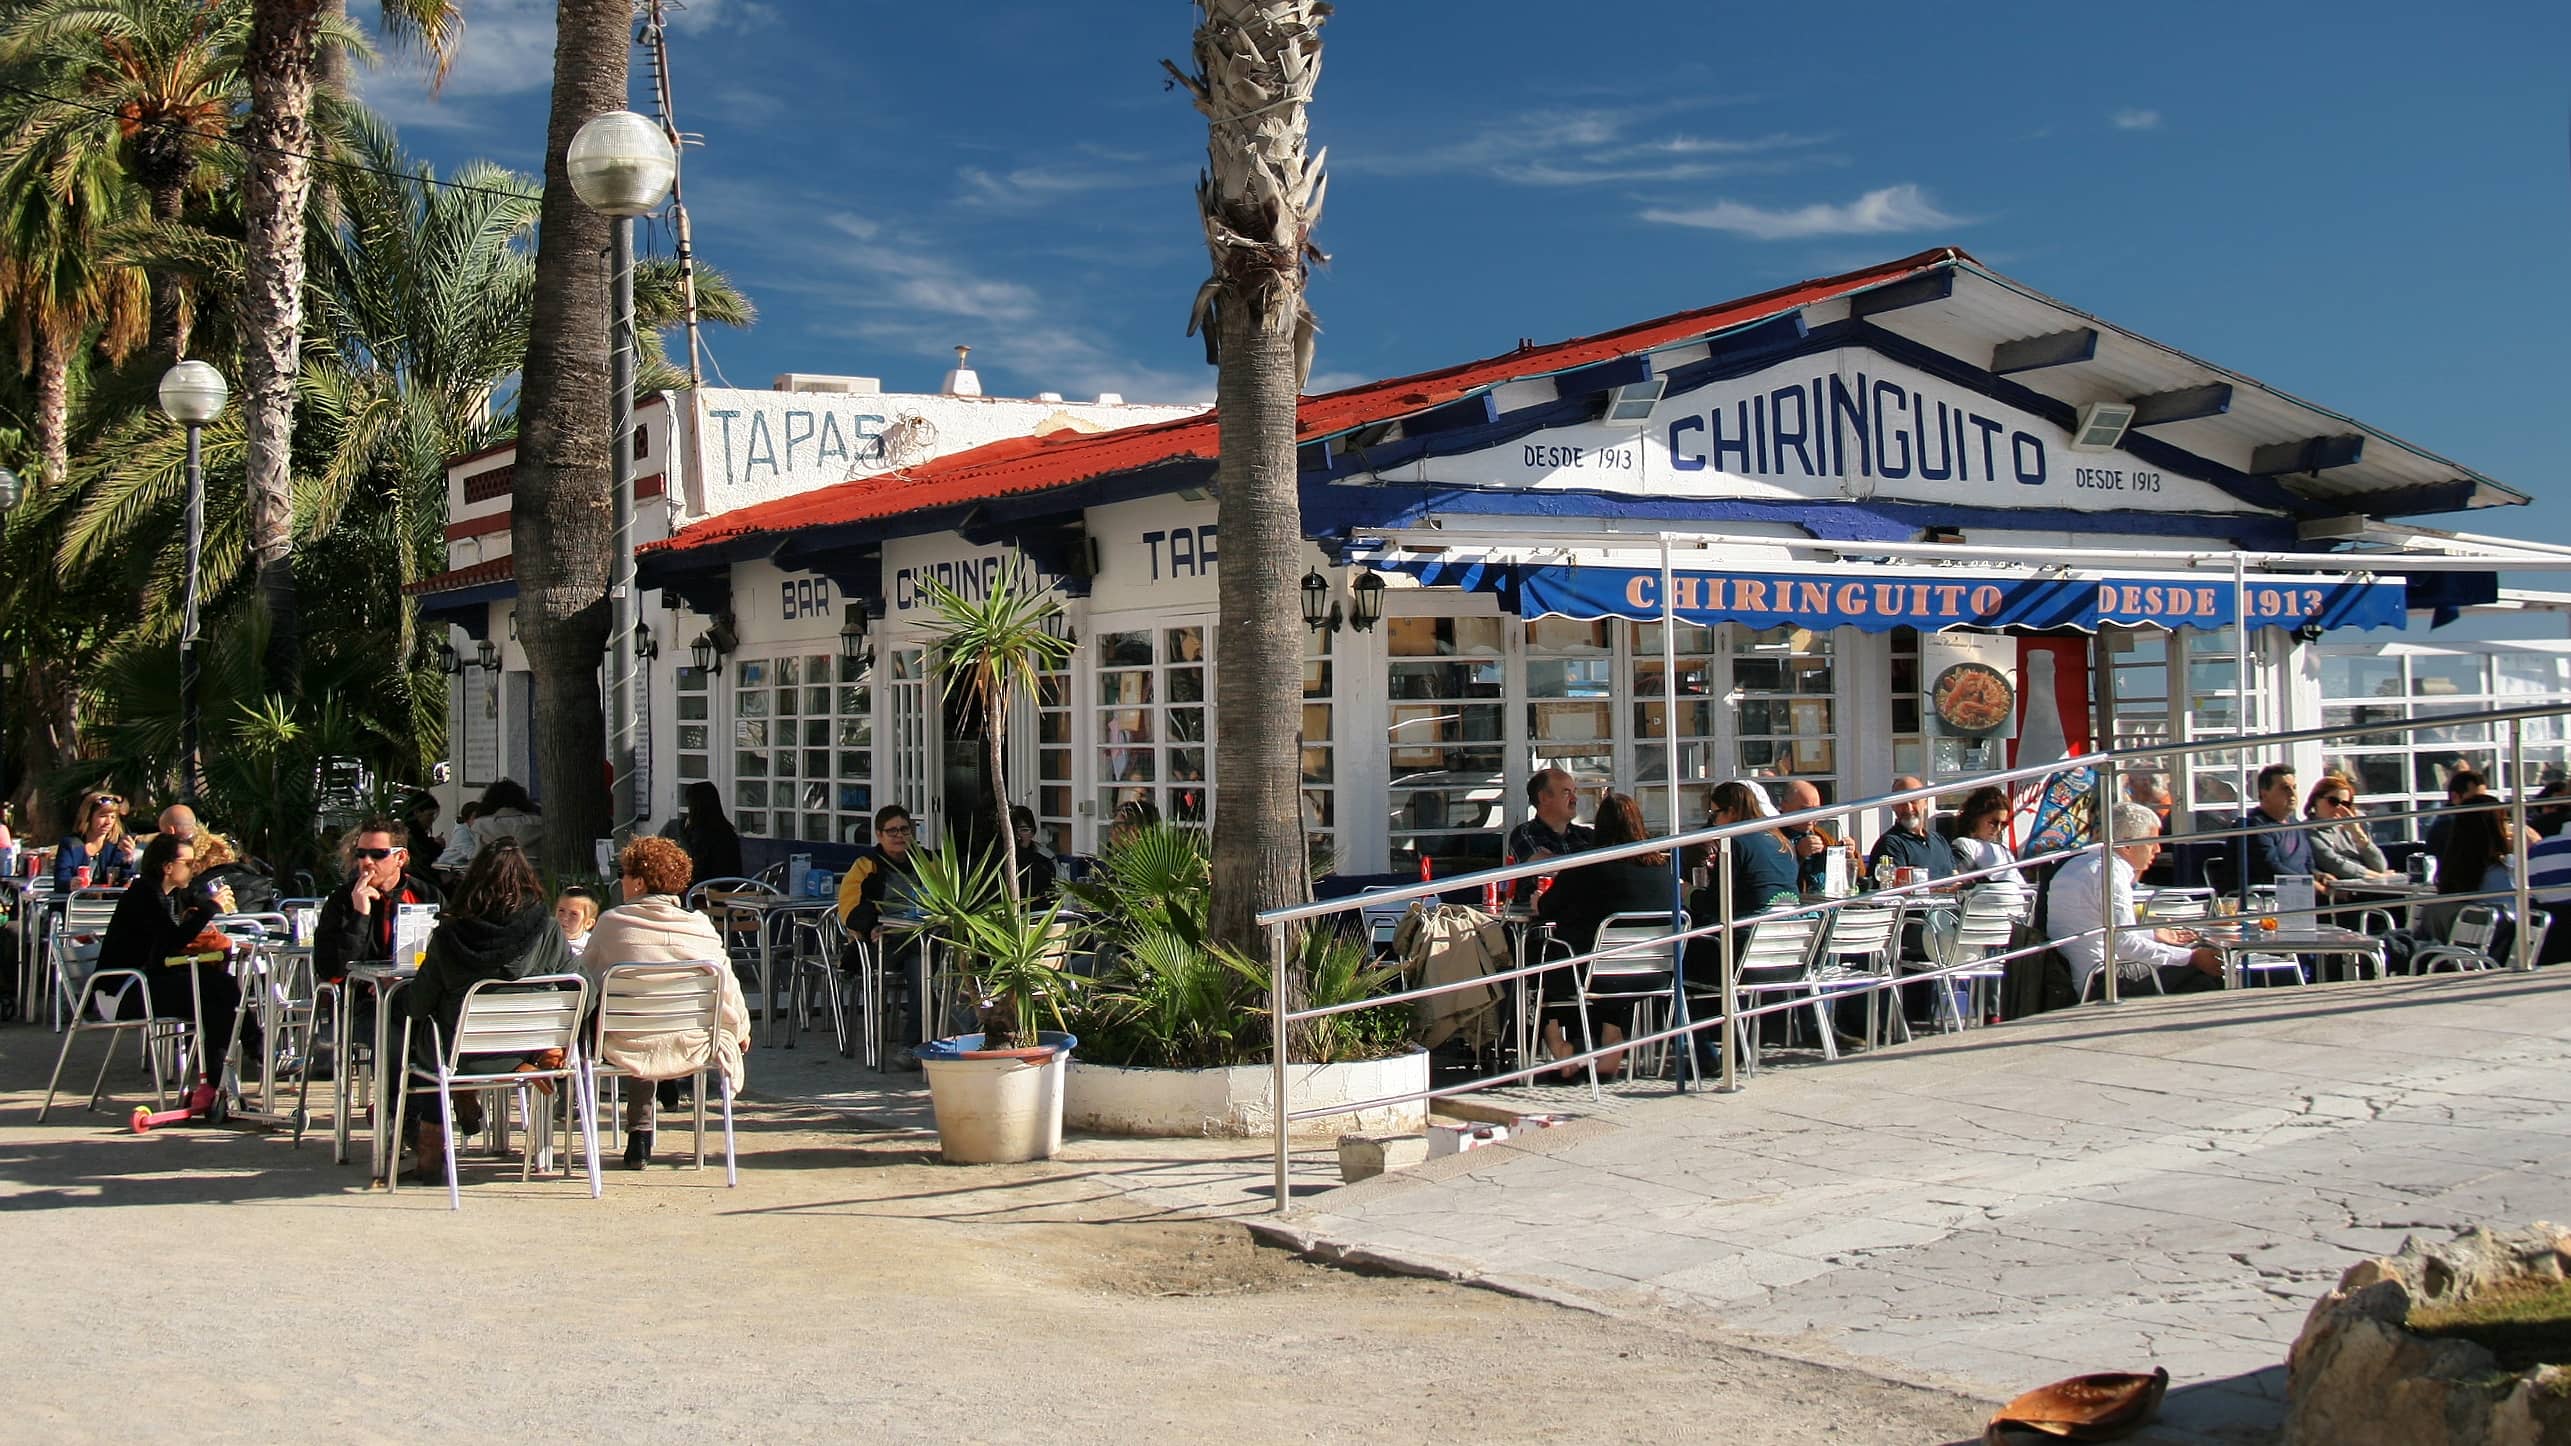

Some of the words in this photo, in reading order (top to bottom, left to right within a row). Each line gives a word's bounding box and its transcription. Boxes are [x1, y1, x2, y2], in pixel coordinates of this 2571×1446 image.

[709, 410, 885, 485] TAPAS
[1669, 372, 2046, 485] CHIRINGUITO
[1524, 445, 1584, 468] DESDE
[1598, 447, 1632, 469] 1913
[2076, 468, 2124, 490] DESDE
[2132, 472, 2160, 492] 1913
[782, 578, 830, 619] BAR
[1625, 575, 2003, 616] CHIRINGUITO
[2098, 585, 2216, 616] DESDE
[2243, 588, 2325, 617] 1913
